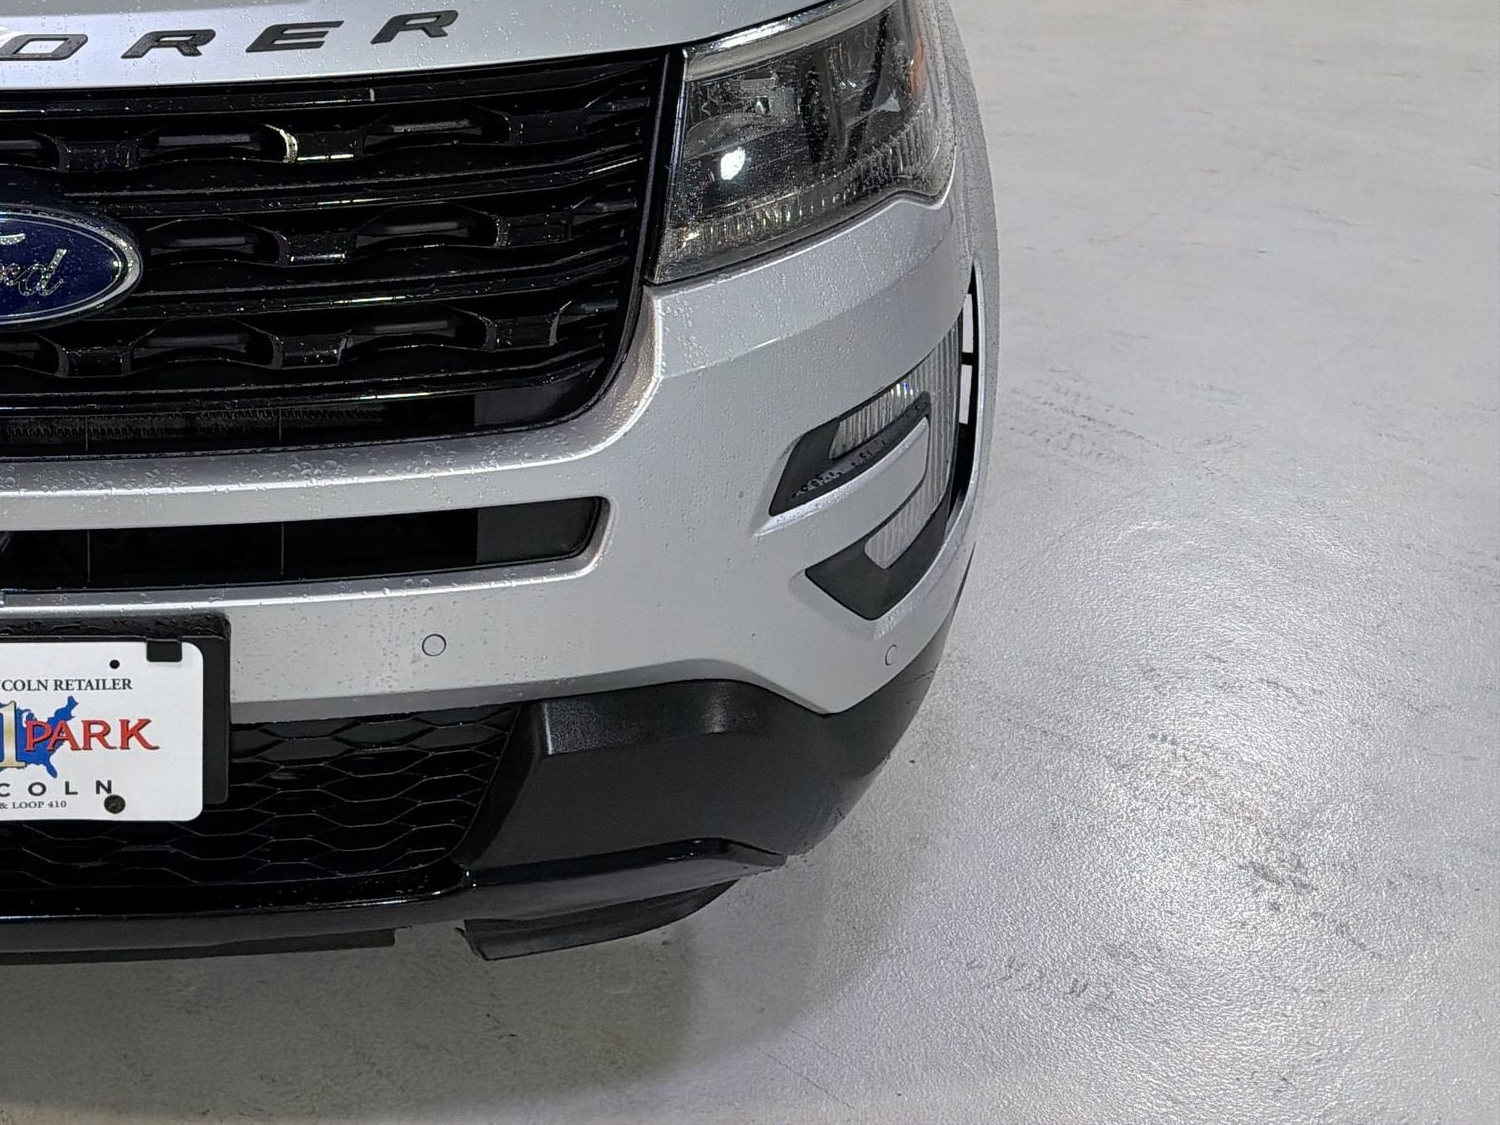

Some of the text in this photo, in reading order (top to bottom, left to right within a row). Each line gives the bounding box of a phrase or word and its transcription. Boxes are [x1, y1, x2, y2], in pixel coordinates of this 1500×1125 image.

[53, 678, 133, 691] RETAILER
[24, 718, 160, 752] PARK
[12, 801, 45, 810] LOOP
[47, 800, 67, 809] 410
